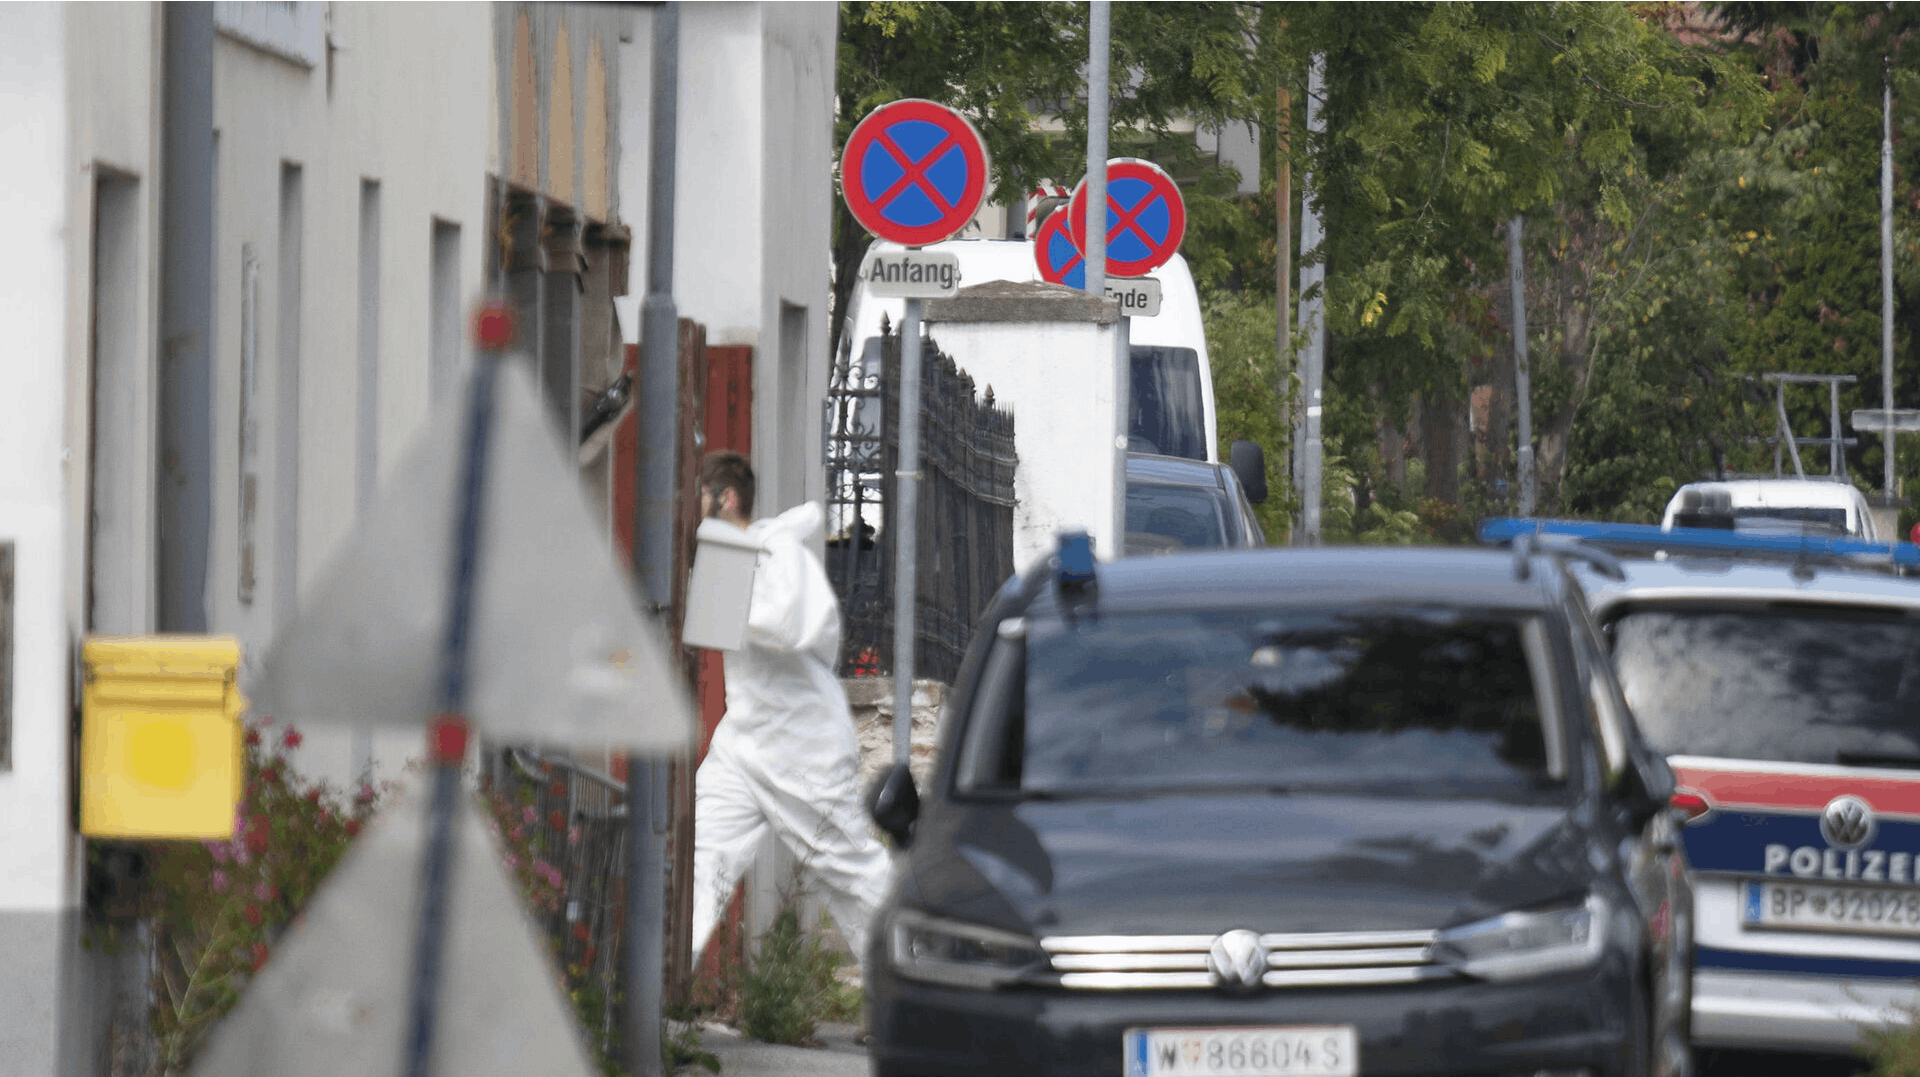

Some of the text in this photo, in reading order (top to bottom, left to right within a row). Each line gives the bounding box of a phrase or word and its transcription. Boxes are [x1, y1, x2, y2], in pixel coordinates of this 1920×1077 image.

[870, 257, 953, 290] Anfang
[1772, 887, 1806, 917] BP
[1155, 1036, 1341, 1071] W 86604 S
